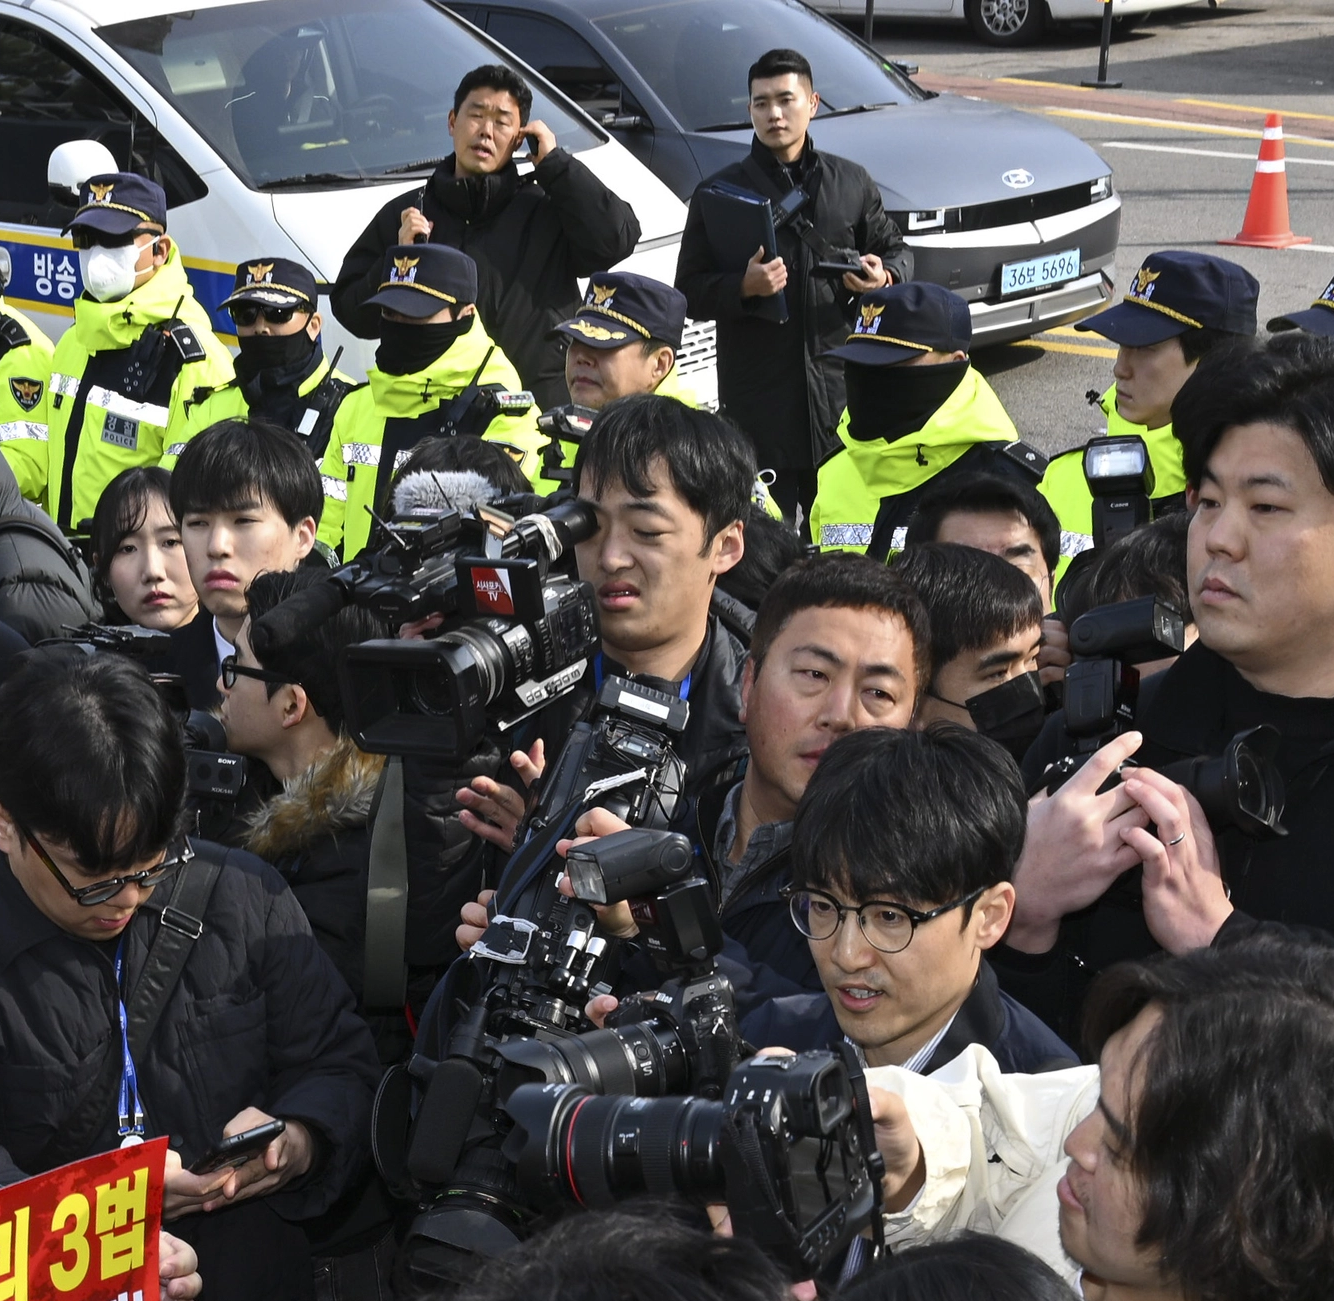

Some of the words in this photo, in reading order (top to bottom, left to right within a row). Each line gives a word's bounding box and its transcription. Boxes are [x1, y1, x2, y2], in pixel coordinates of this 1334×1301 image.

[34, 253, 77, 300] 방송
[1009, 266, 1036, 288] 36보
[1042, 255, 1074, 281] 5696
[103, 432, 134, 447] POLICE
[487, 591, 498, 602] TV
[217, 757, 237, 766] SONY
[49, 1193, 91, 1292] 3
[95, 1166, 149, 1281] 법
